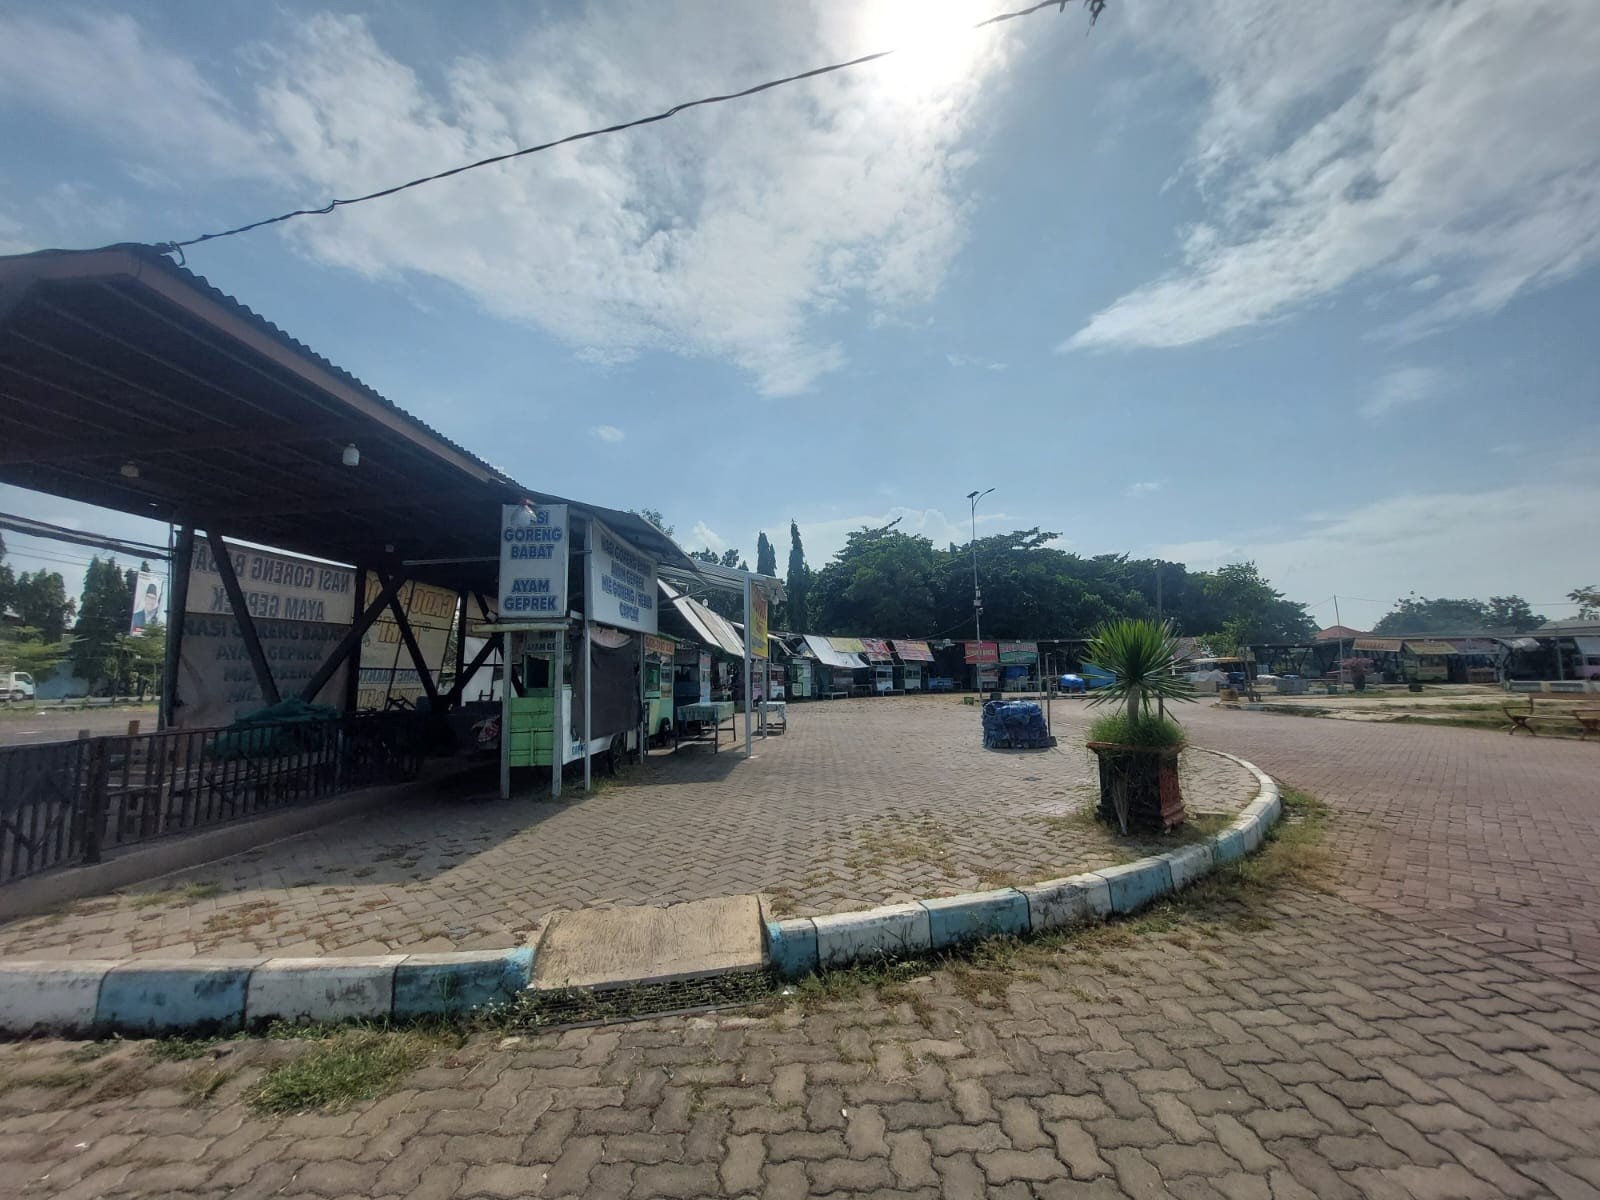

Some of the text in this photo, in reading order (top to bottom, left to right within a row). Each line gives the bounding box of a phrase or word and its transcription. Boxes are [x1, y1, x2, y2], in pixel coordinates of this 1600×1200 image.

[504, 527, 562, 541] GORENG
[511, 545, 554, 560] BABAT
[512, 579, 550, 593] AYAM
[504, 597, 557, 611] GEPREK
[216, 645, 254, 661] AYA
